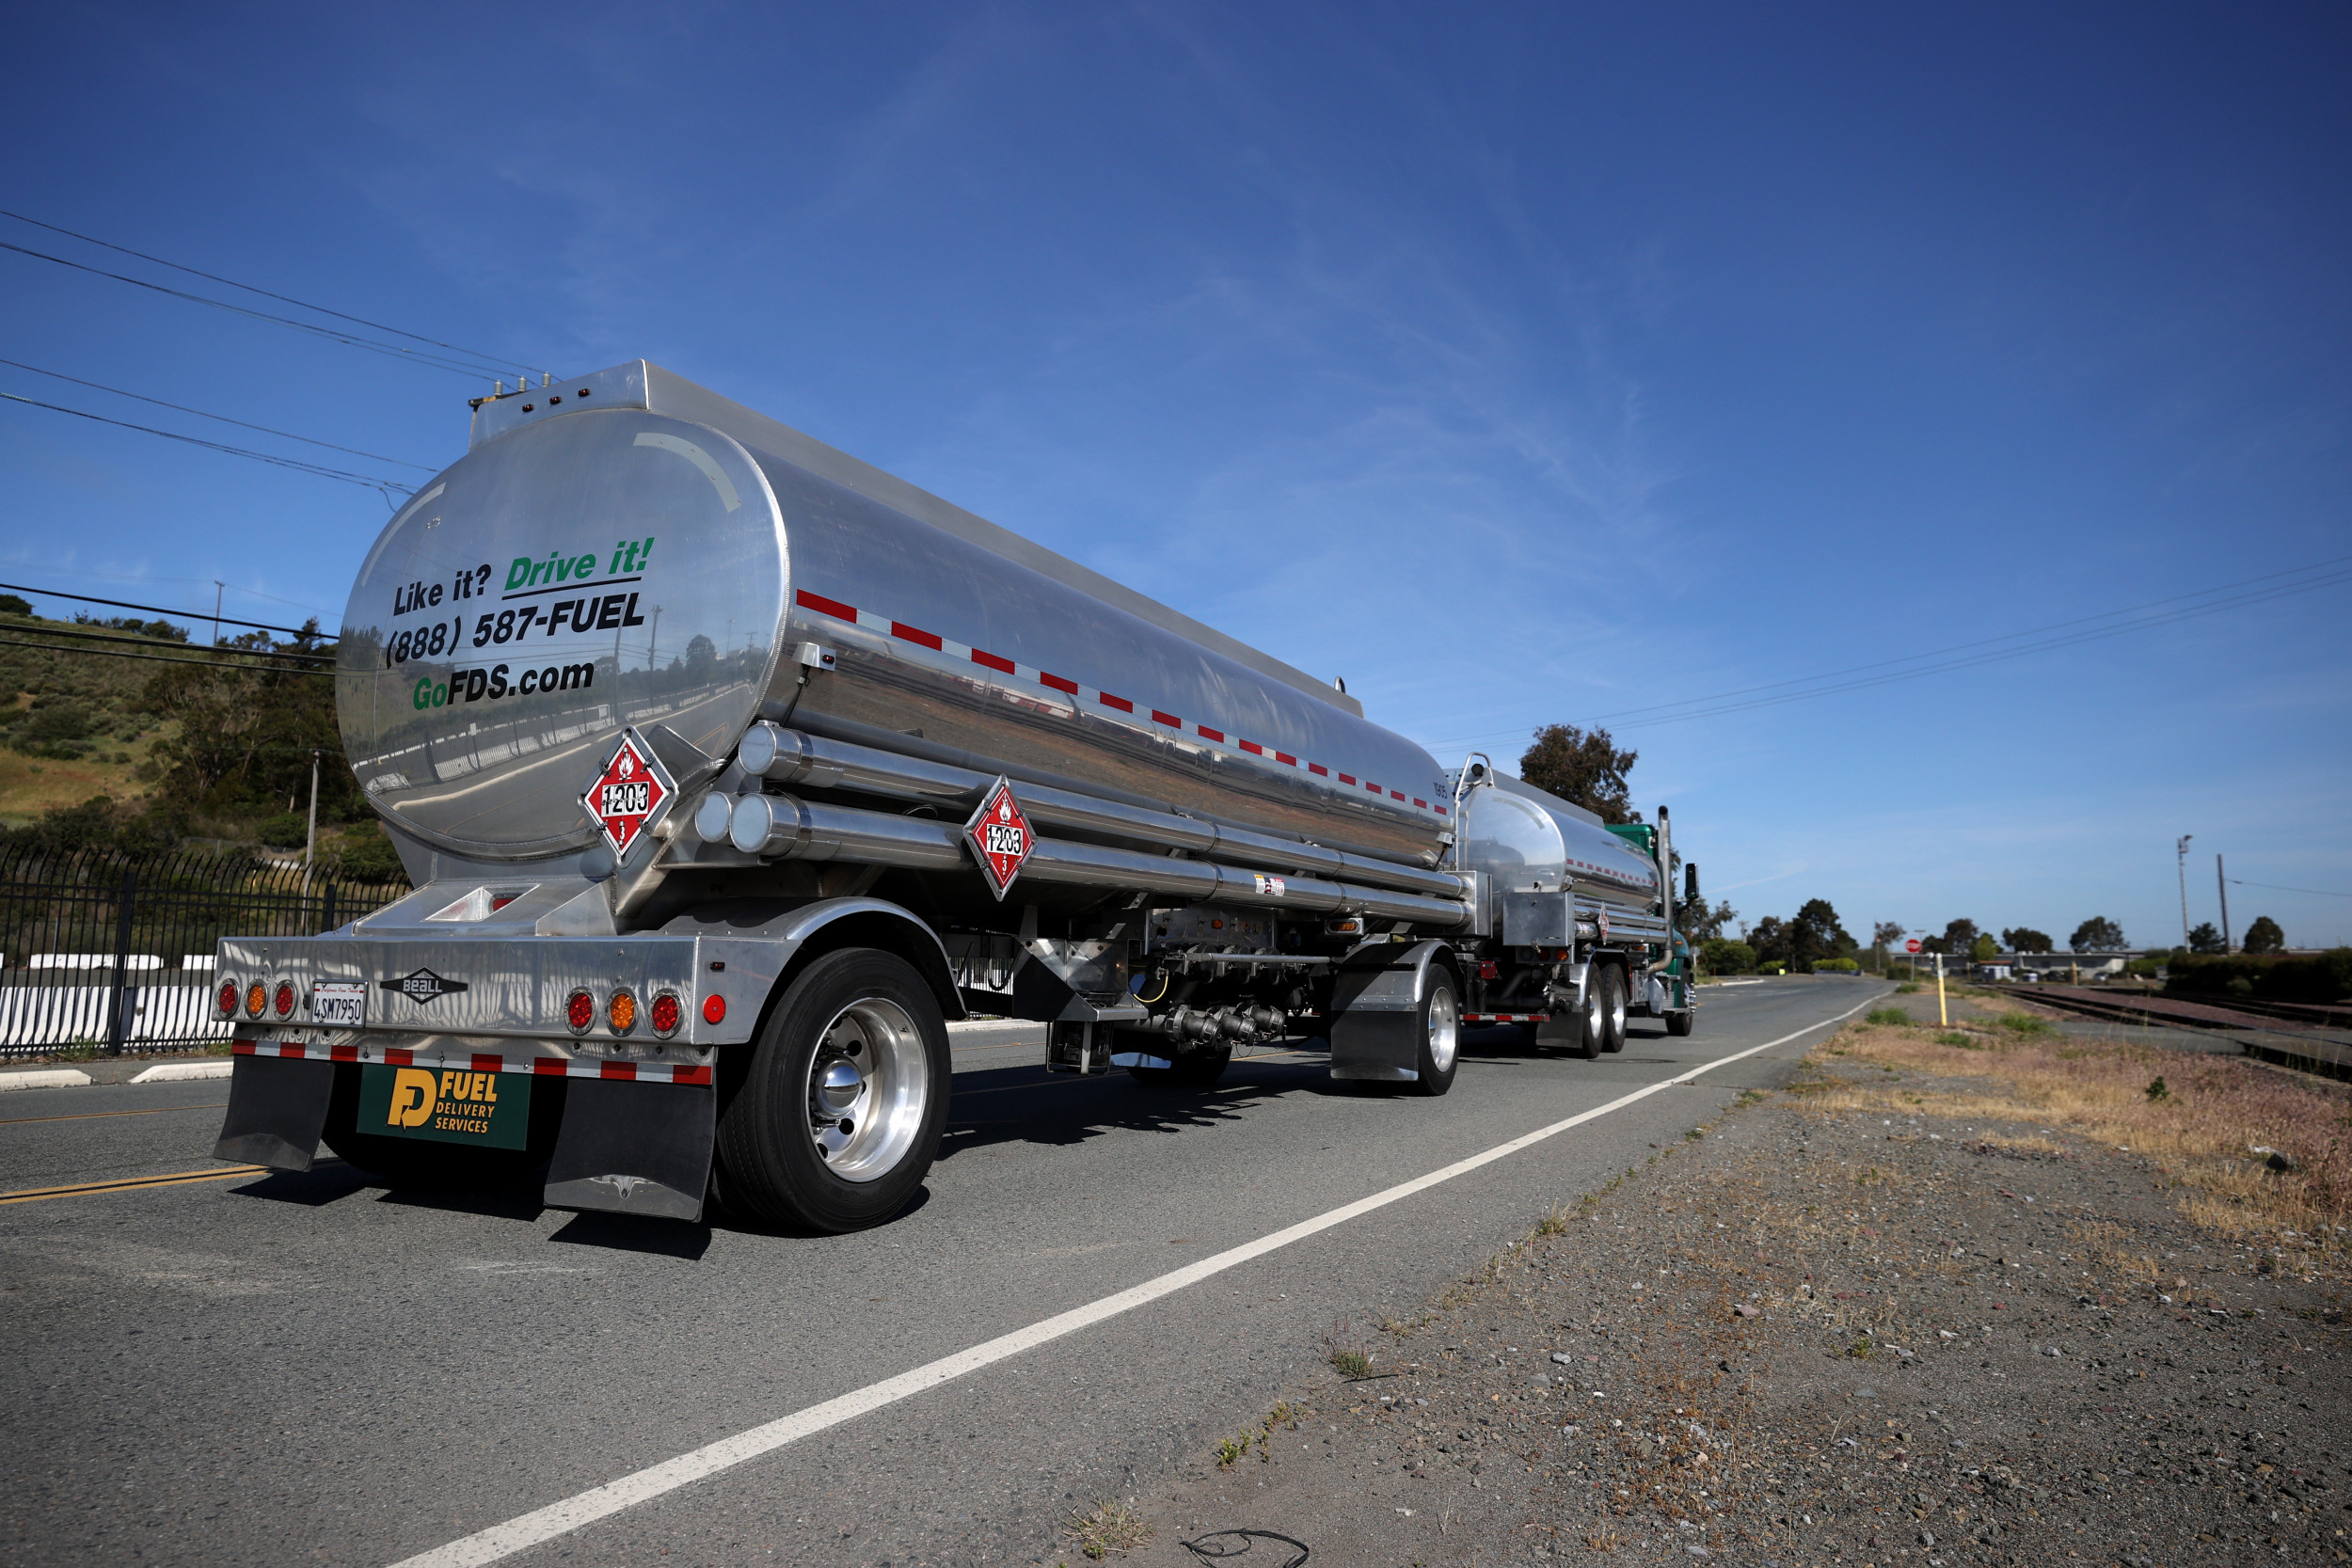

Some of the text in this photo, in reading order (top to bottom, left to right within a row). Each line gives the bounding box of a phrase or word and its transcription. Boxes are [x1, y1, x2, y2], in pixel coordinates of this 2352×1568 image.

[393, 537, 655, 616] Like it? Drive it!
[387, 592, 644, 670] (888) 587-FUEL
[413, 662, 595, 711] GoFDS.com
[604, 783, 649, 815] 1203
[1433, 782, 1448, 800] 1905
[988, 825, 1022, 855] 1203
[314, 998, 361, 1020] 4SM7950
[438, 1071, 497, 1102] FUEL
[436, 1101, 495, 1118] DELIVERY
[435, 1117, 488, 1133] SERVICES
